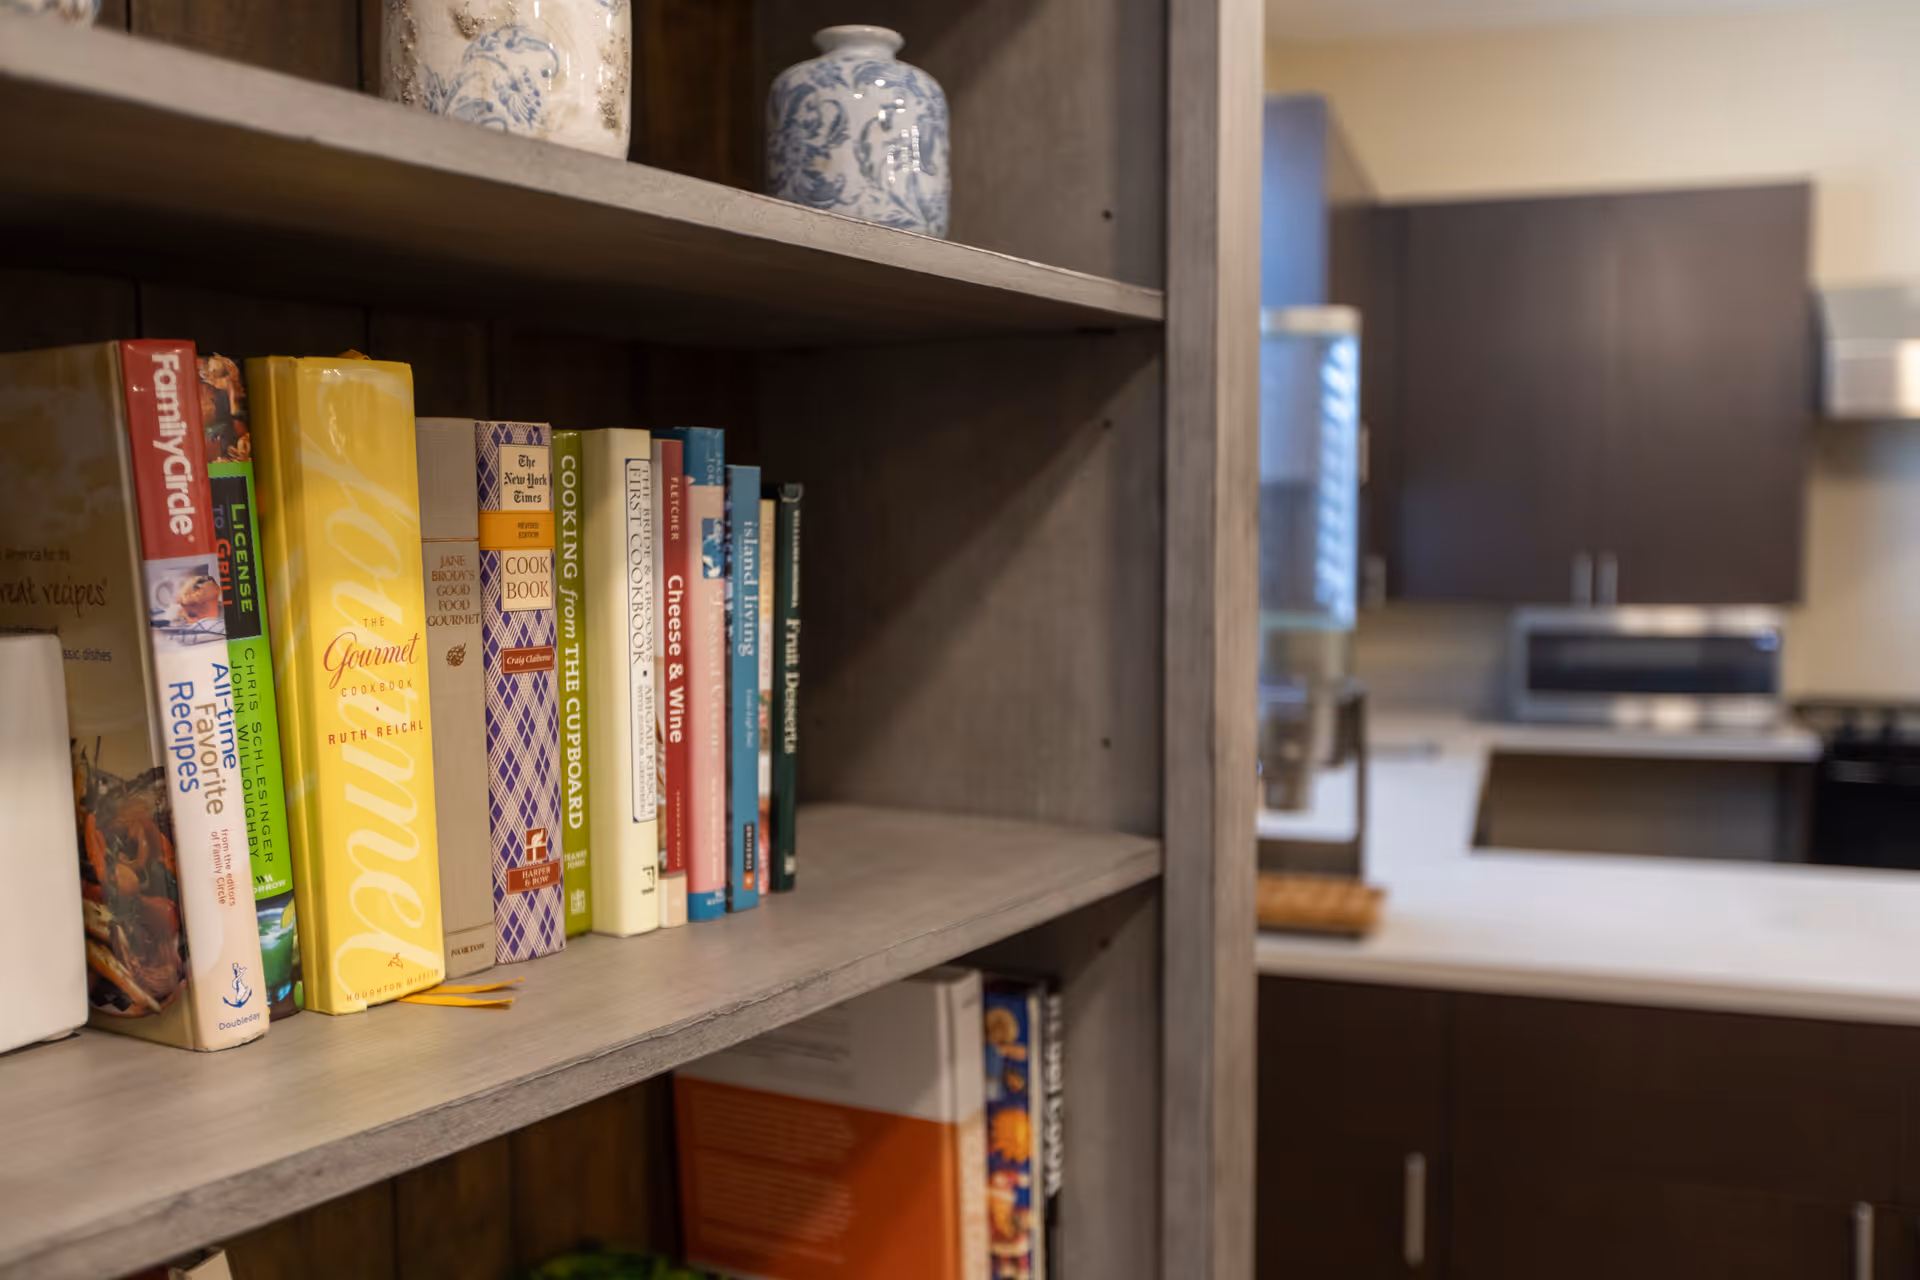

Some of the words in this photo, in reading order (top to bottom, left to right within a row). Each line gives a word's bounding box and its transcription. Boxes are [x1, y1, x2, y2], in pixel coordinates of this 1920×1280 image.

[518, 454, 536, 469] The
[504, 471, 525, 486] New
[526, 472, 547, 489] York
[513, 490, 542, 504] Times
[629, 467, 642, 527] FIRST
[670, 477, 679, 540] FLETCHER
[213, 505, 224, 529] TO
[561, 455, 578, 579] COOKING
[231, 504, 252, 612] LICENSE
[440, 555, 467, 569] JANE
[505, 556, 549, 575] COOK
[744, 521, 759, 585] island
[436, 584, 471, 596] GOOD
[438, 599, 471, 611] FOOD
[506, 580, 549, 600] BOOK
[630, 533, 645, 665] COOKBOOK
[362, 617, 385, 628] THE
[426, 613, 480, 627] GOURMET
[559, 584, 578, 639] from
[667, 575, 684, 656] Cheese
[738, 595, 759, 657] living
[785, 618, 801, 666] Fruit
[323, 631, 421, 690] Gourmet
[506, 655, 525, 666] Craig
[565, 643, 580, 692] THE
[668, 663, 684, 681] &
[231, 661, 245, 713] JOHN
[341, 678, 413, 698] COOKBOOK
[211, 663, 237, 769] All-time
[669, 686, 684, 743] Wine
[784, 672, 801, 753] Desserts
[169, 681, 199, 793] Recipes
[328, 729, 368, 745] RUTH
[376, 720, 424, 737] REICHL
[194, 703, 227, 815] Favorite
[244, 648, 259, 711] CHRIS
[252, 722, 273, 863] SCHLESINGER
[566, 697, 583, 829] CUPBOARD
[237, 725, 260, 858] WILLOUGHBY
[220, 829, 229, 851] from
[211, 843, 222, 875] Family
[223, 853, 231, 870] the
[522, 865, 551, 879] HARPER
[215, 877, 226, 906] Circle
[226, 873, 236, 907] editors
[524, 879, 531, 888] &
[532, 875, 549, 887] ROW
[219, 1012, 261, 1031] Doubleday
